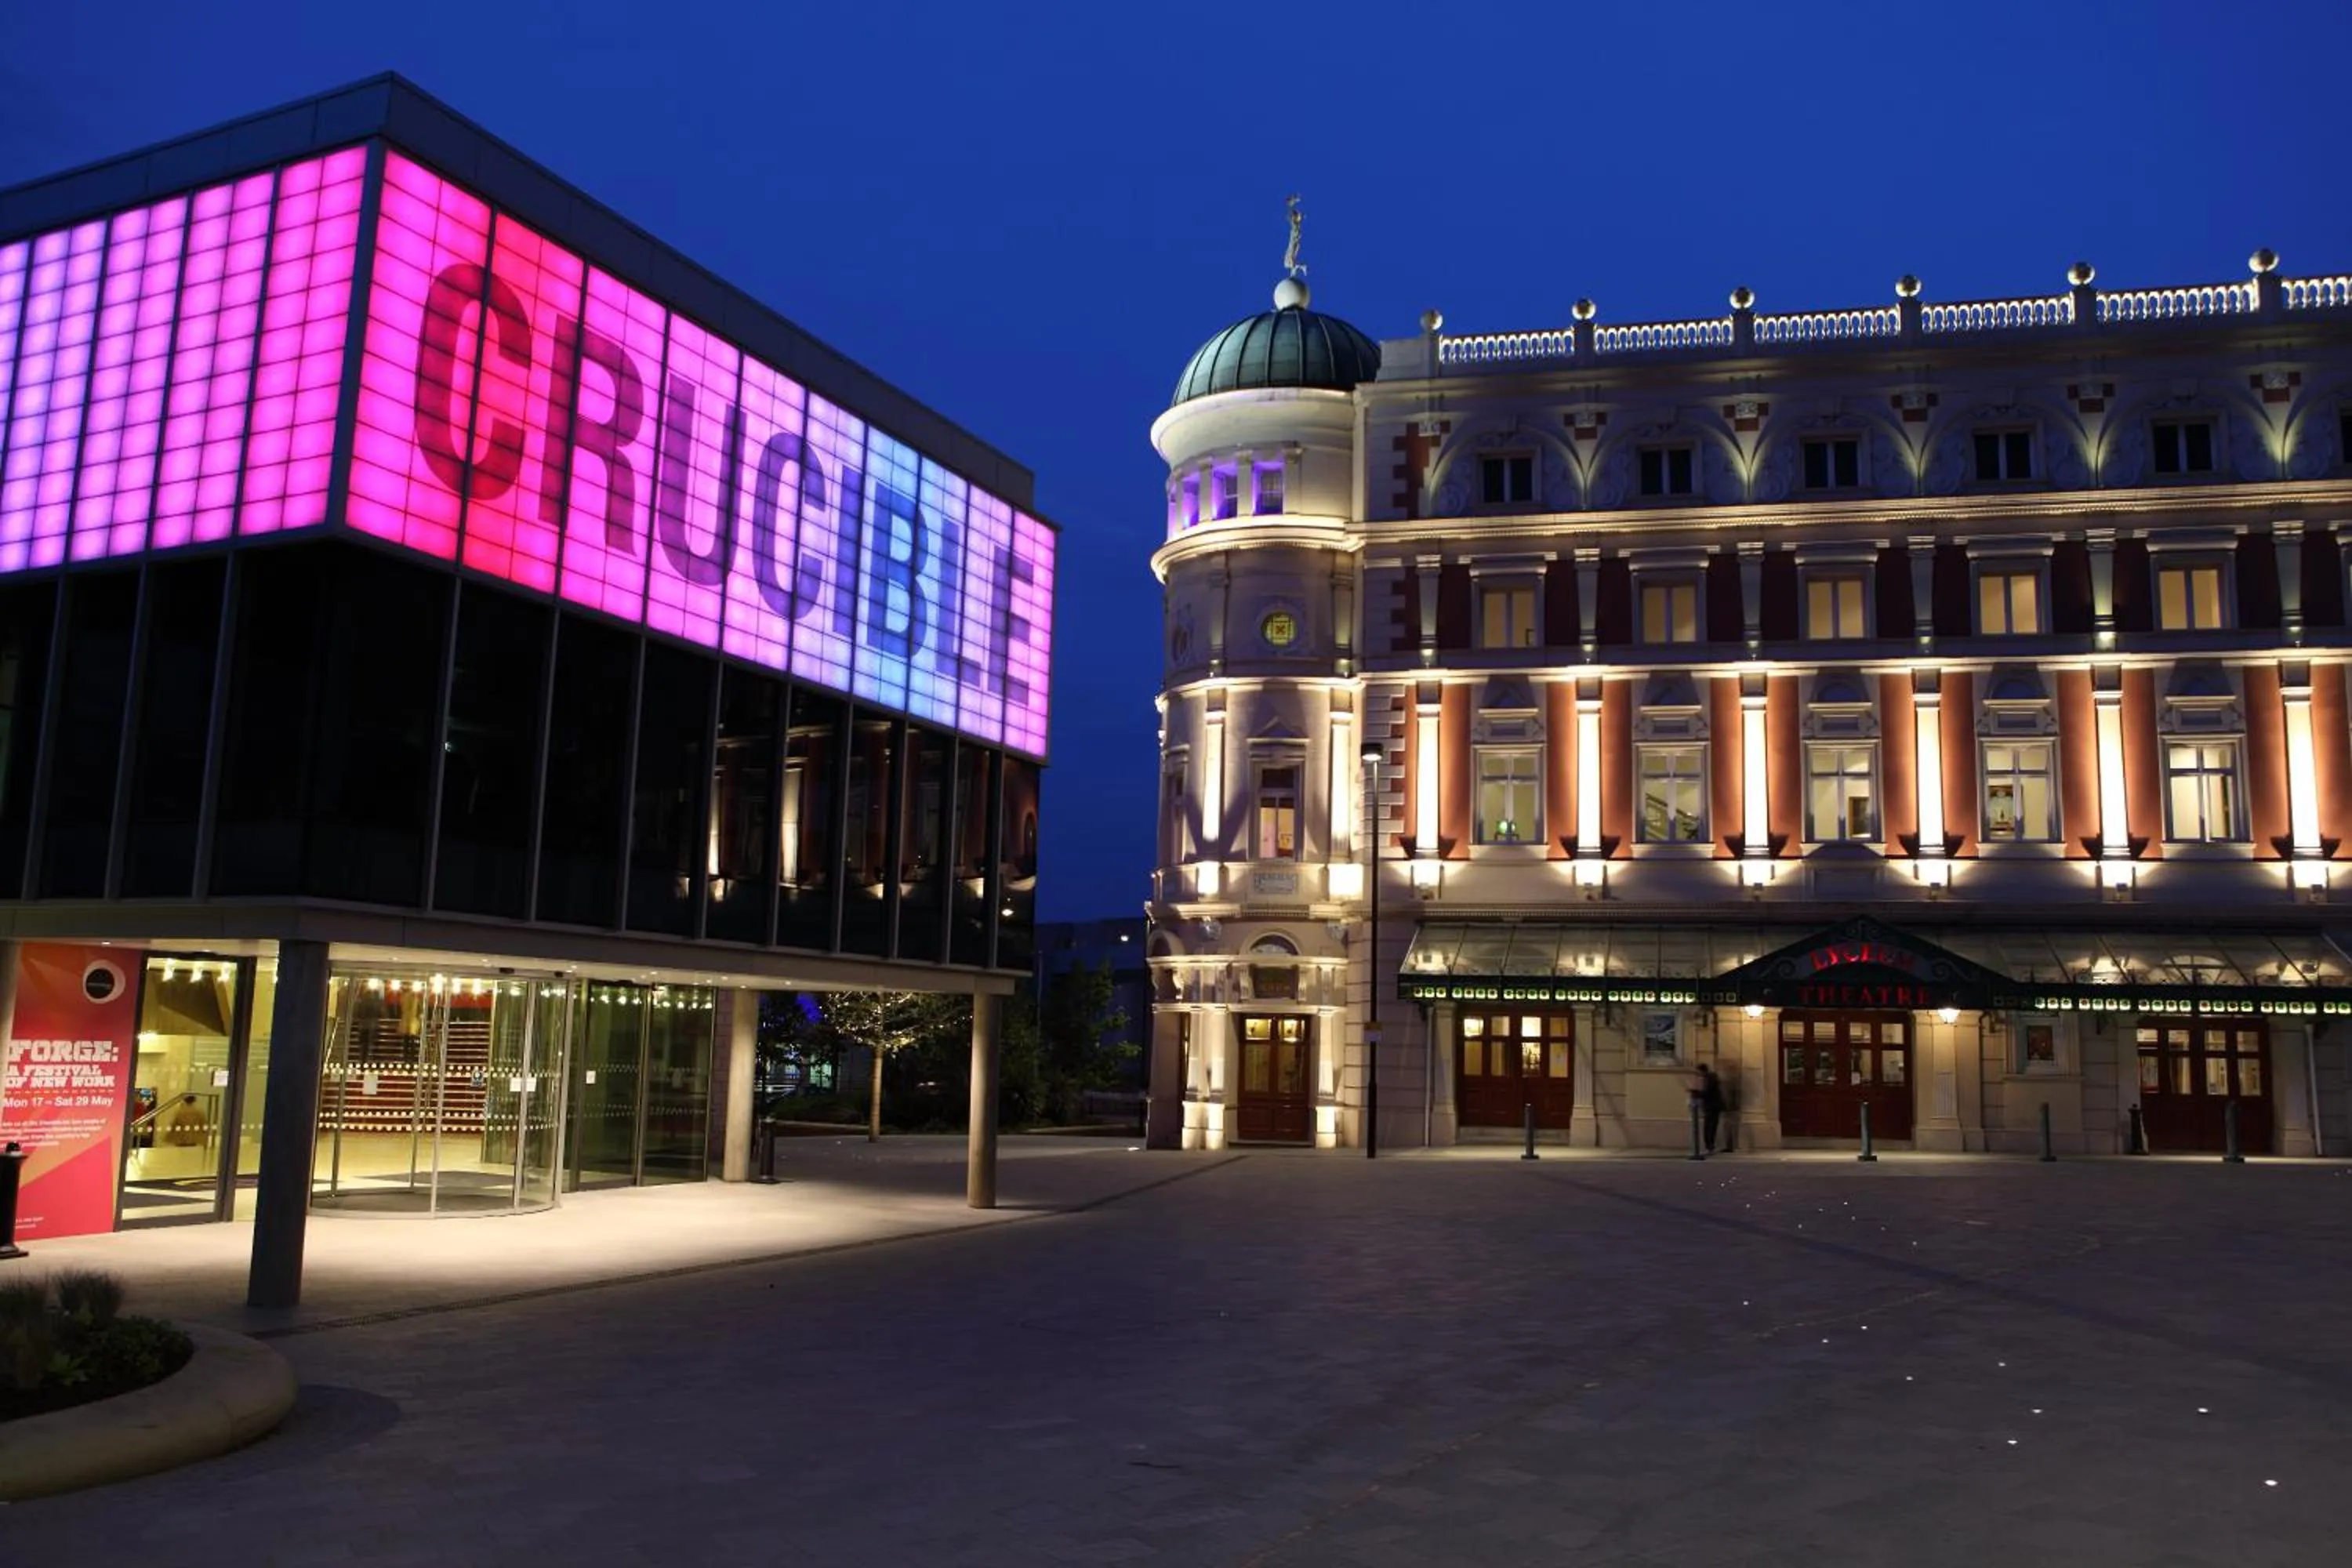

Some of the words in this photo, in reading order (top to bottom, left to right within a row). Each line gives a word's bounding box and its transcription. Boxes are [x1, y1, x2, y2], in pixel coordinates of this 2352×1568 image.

[415, 263, 1035, 705] CRUCIBLE
[1798, 985, 1930, 1004] THEATRE
[8, 1040, 119, 1062] FORGE:
[6, 1064, 20, 1076] A
[24, 1064, 101, 1076] FESTIVAL
[5, 1076, 27, 1088] OF
[30, 1075, 67, 1087] NEW
[71, 1075, 115, 1087] WORK
[3, 1098, 28, 1107] Mon
[31, 1097, 43, 1107] 17
[54, 1096, 73, 1106] Sat
[75, 1095, 89, 1105] 29
[91, 1095, 114, 1107] May
